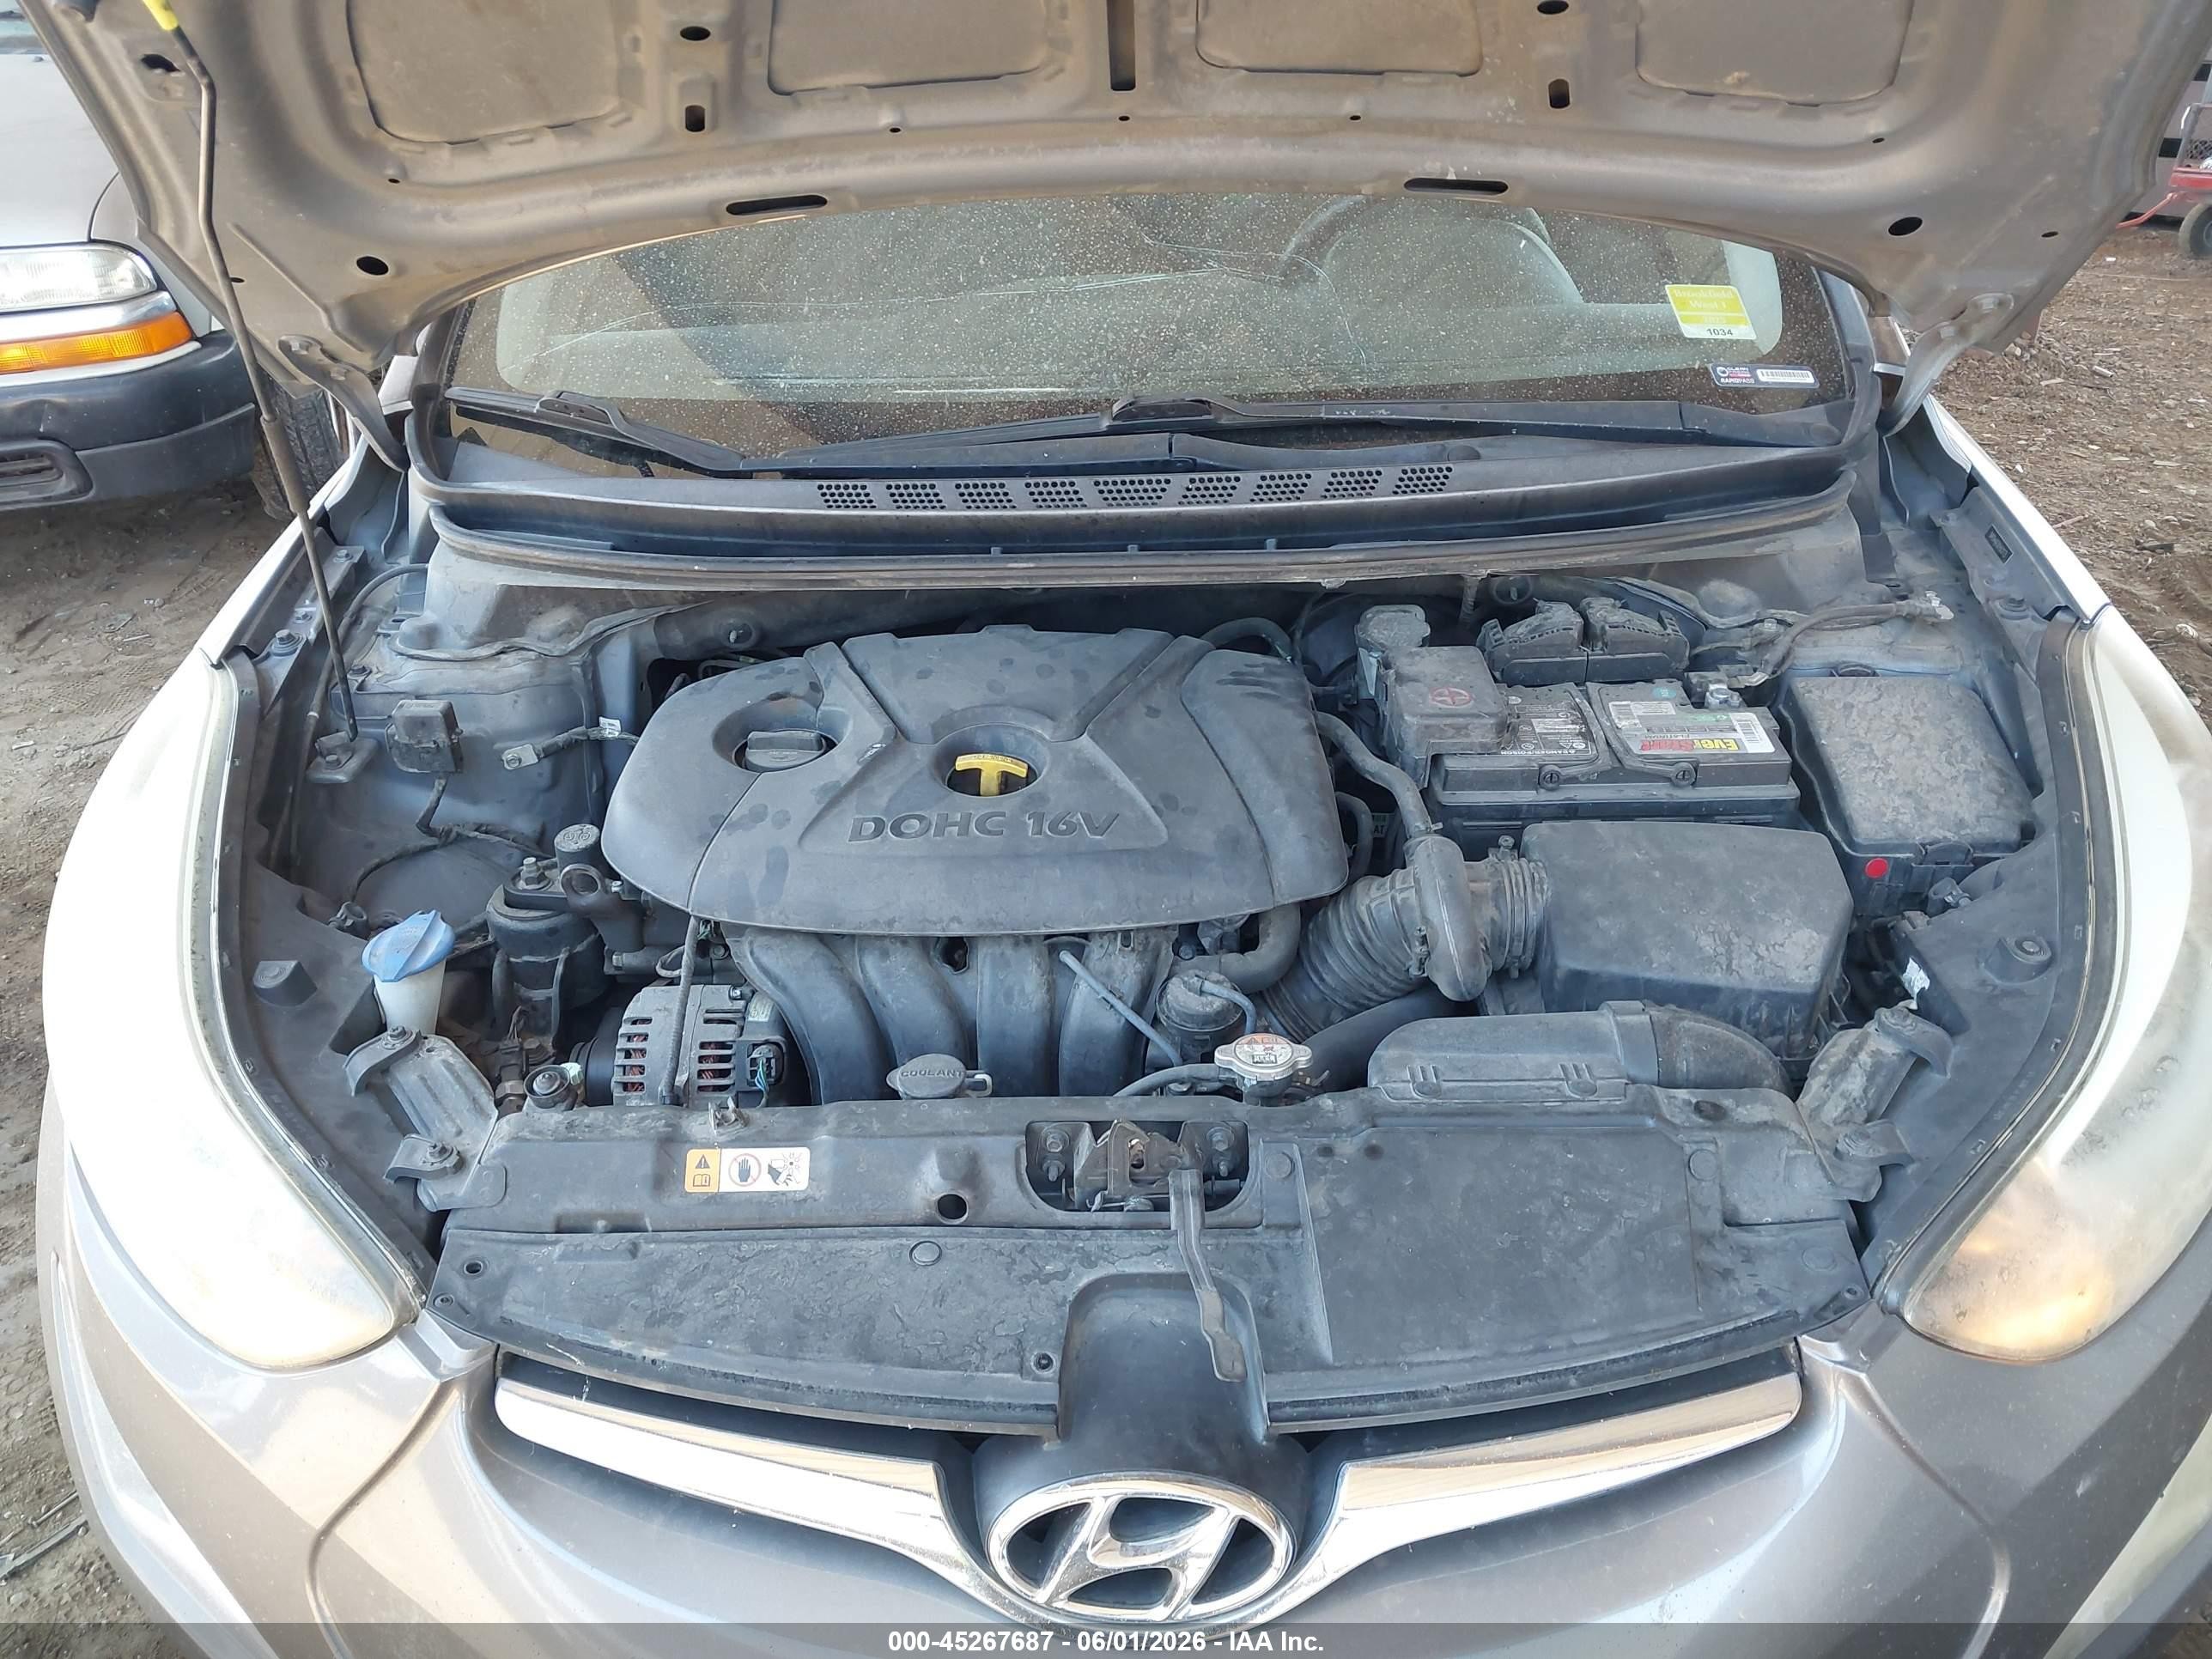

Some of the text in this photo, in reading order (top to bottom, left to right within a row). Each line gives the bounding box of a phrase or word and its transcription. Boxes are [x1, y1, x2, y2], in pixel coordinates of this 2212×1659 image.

[1706, 328, 1733, 337] 1034
[1639, 738, 1740, 752] EverStart
[848, 811, 1120, 842] DOHC 16V
[901, 1069, 963, 1079] COOLANT
